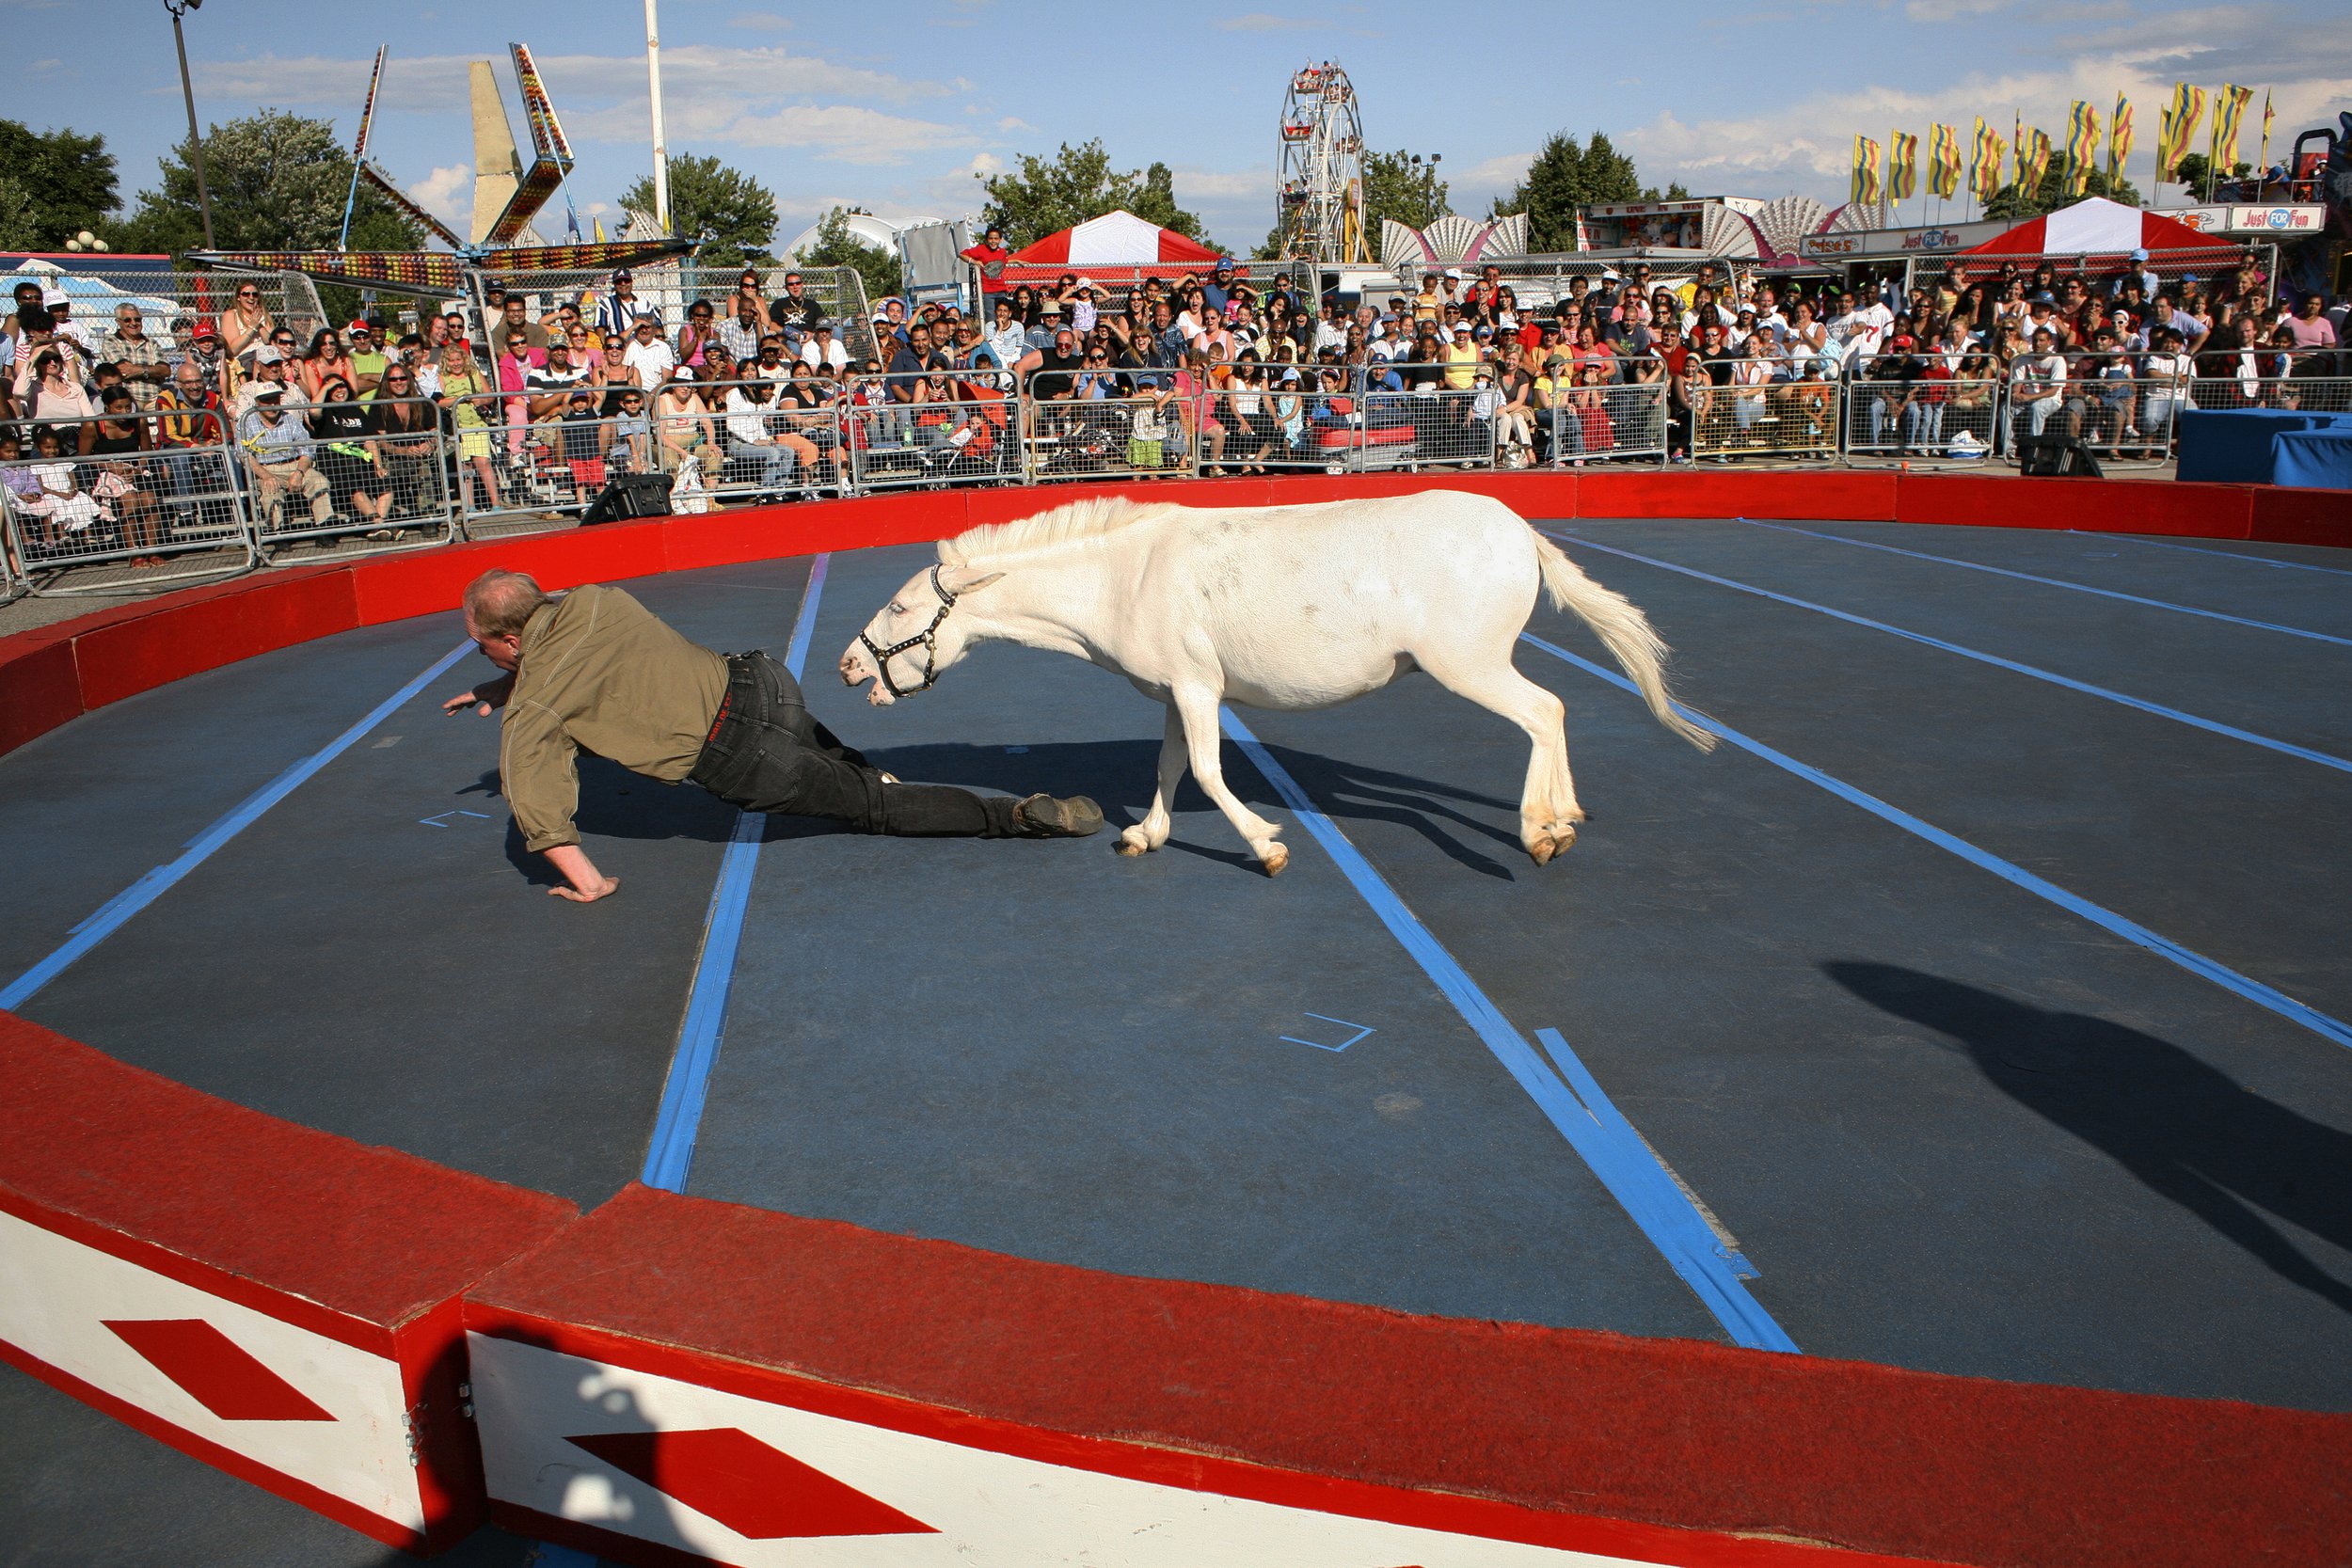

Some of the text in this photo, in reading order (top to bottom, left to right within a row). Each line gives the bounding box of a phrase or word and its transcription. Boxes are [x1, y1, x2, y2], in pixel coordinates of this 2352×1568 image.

[2243, 209, 2309, 228] Just FOR Fun
[1901, 230, 1959, 249] Just FOR Fun
[1866, 325, 1879, 342] 7
